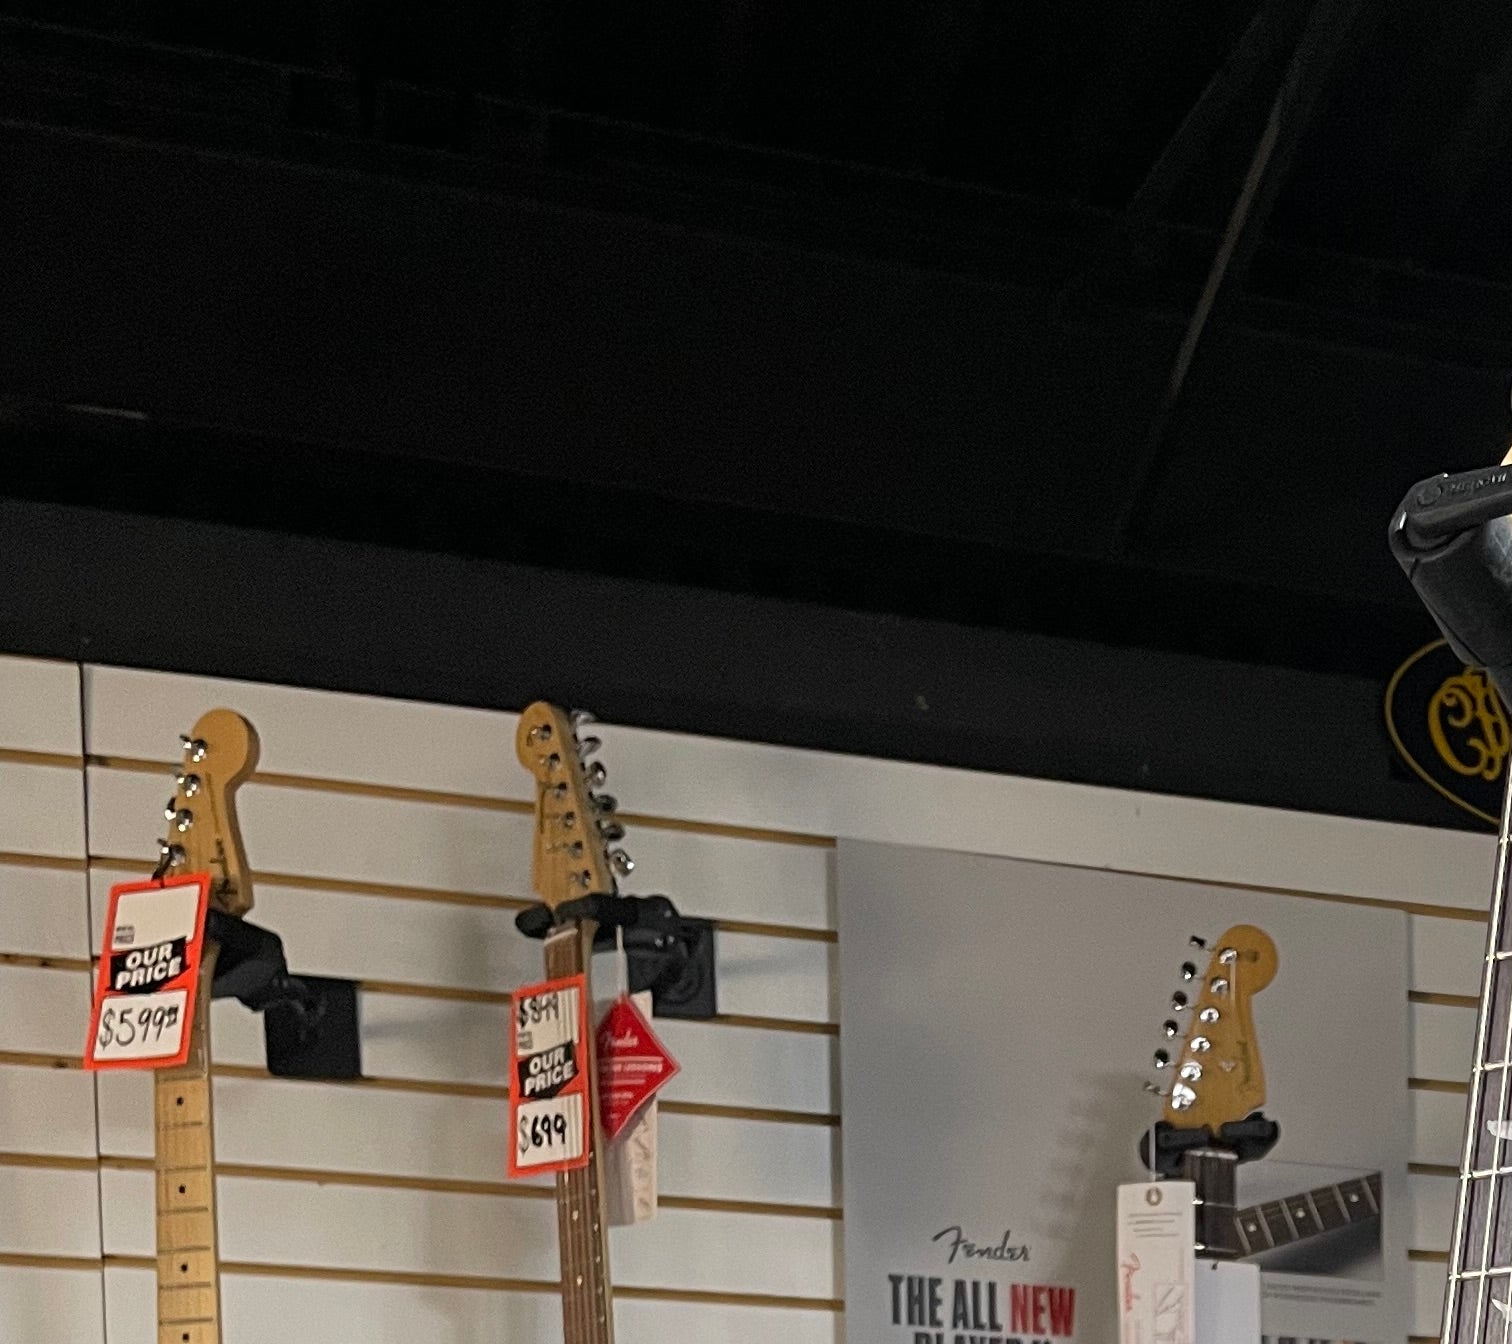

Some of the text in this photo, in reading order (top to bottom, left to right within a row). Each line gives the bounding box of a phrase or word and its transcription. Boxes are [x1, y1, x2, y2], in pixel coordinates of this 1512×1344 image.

[115, 956, 183, 991] PRICE
[125, 943, 173, 971] OUR
[524, 1060, 574, 1097] PRICE
[528, 1048, 565, 1074] OUR
[518, 1113, 568, 1156] $699
[931, 1225, 1031, 1264] Fender
[888, 1274, 1076, 1337] THE ALL NEW
